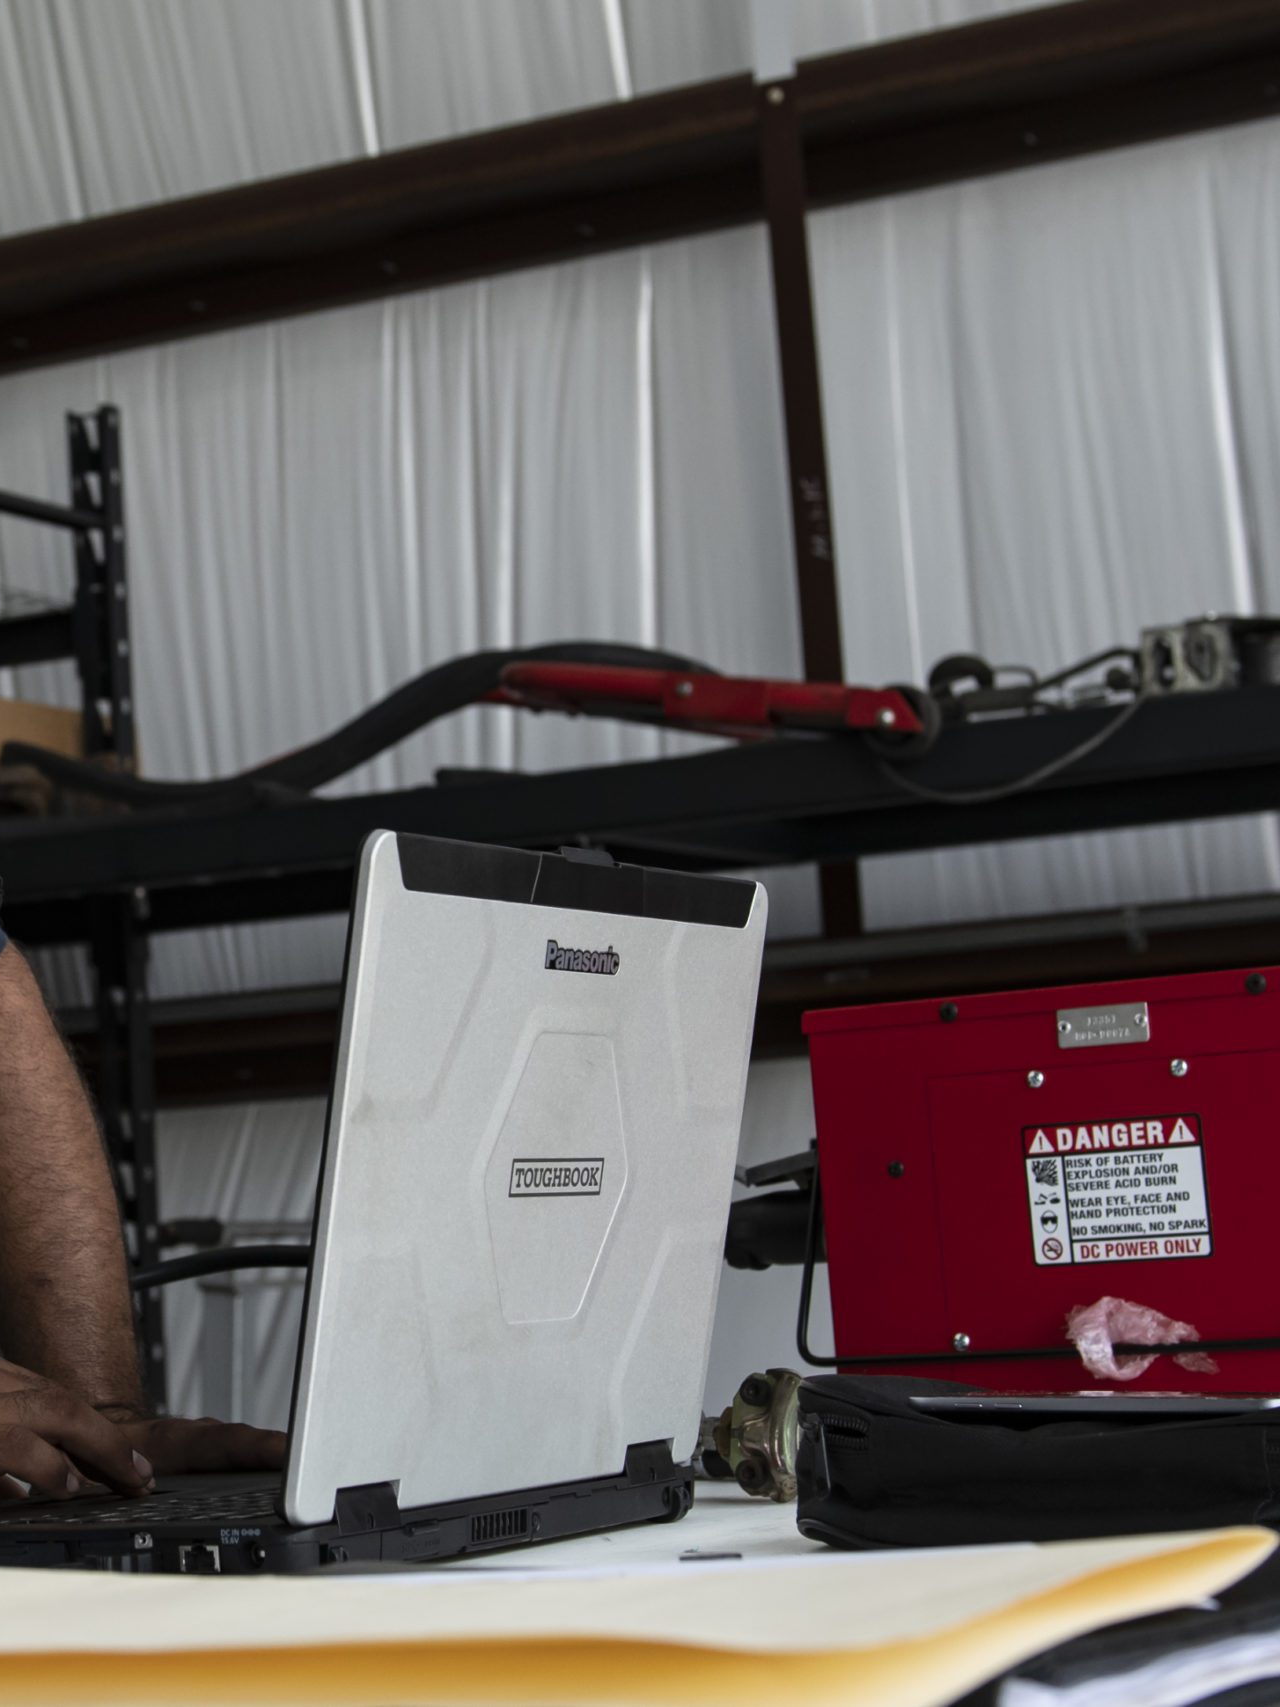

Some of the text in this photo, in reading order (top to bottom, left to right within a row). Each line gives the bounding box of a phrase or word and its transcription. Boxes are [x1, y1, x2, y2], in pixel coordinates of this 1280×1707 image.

[544, 939, 620, 976] Panasonic
[1055, 1121, 1165, 1151] DANGER
[1066, 1153, 1164, 1168] RISK OF BATTERY
[515, 1167, 600, 1188] TOUGHBOOK
[1067, 1163, 1179, 1180] EXPLOSION AND/OR
[1068, 1176, 1177, 1192] SEVERE ACID BURN
[1070, 1191, 1190, 1208] WEAR EYE, FACE AND
[1071, 1204, 1177, 1220] HAND PROTECTION
[1073, 1219, 1207, 1236] NO SMOKING, NO SPARK
[1080, 1238, 1202, 1260] DC POWER ONLY
[221, 1528, 240, 1537] DC IN
